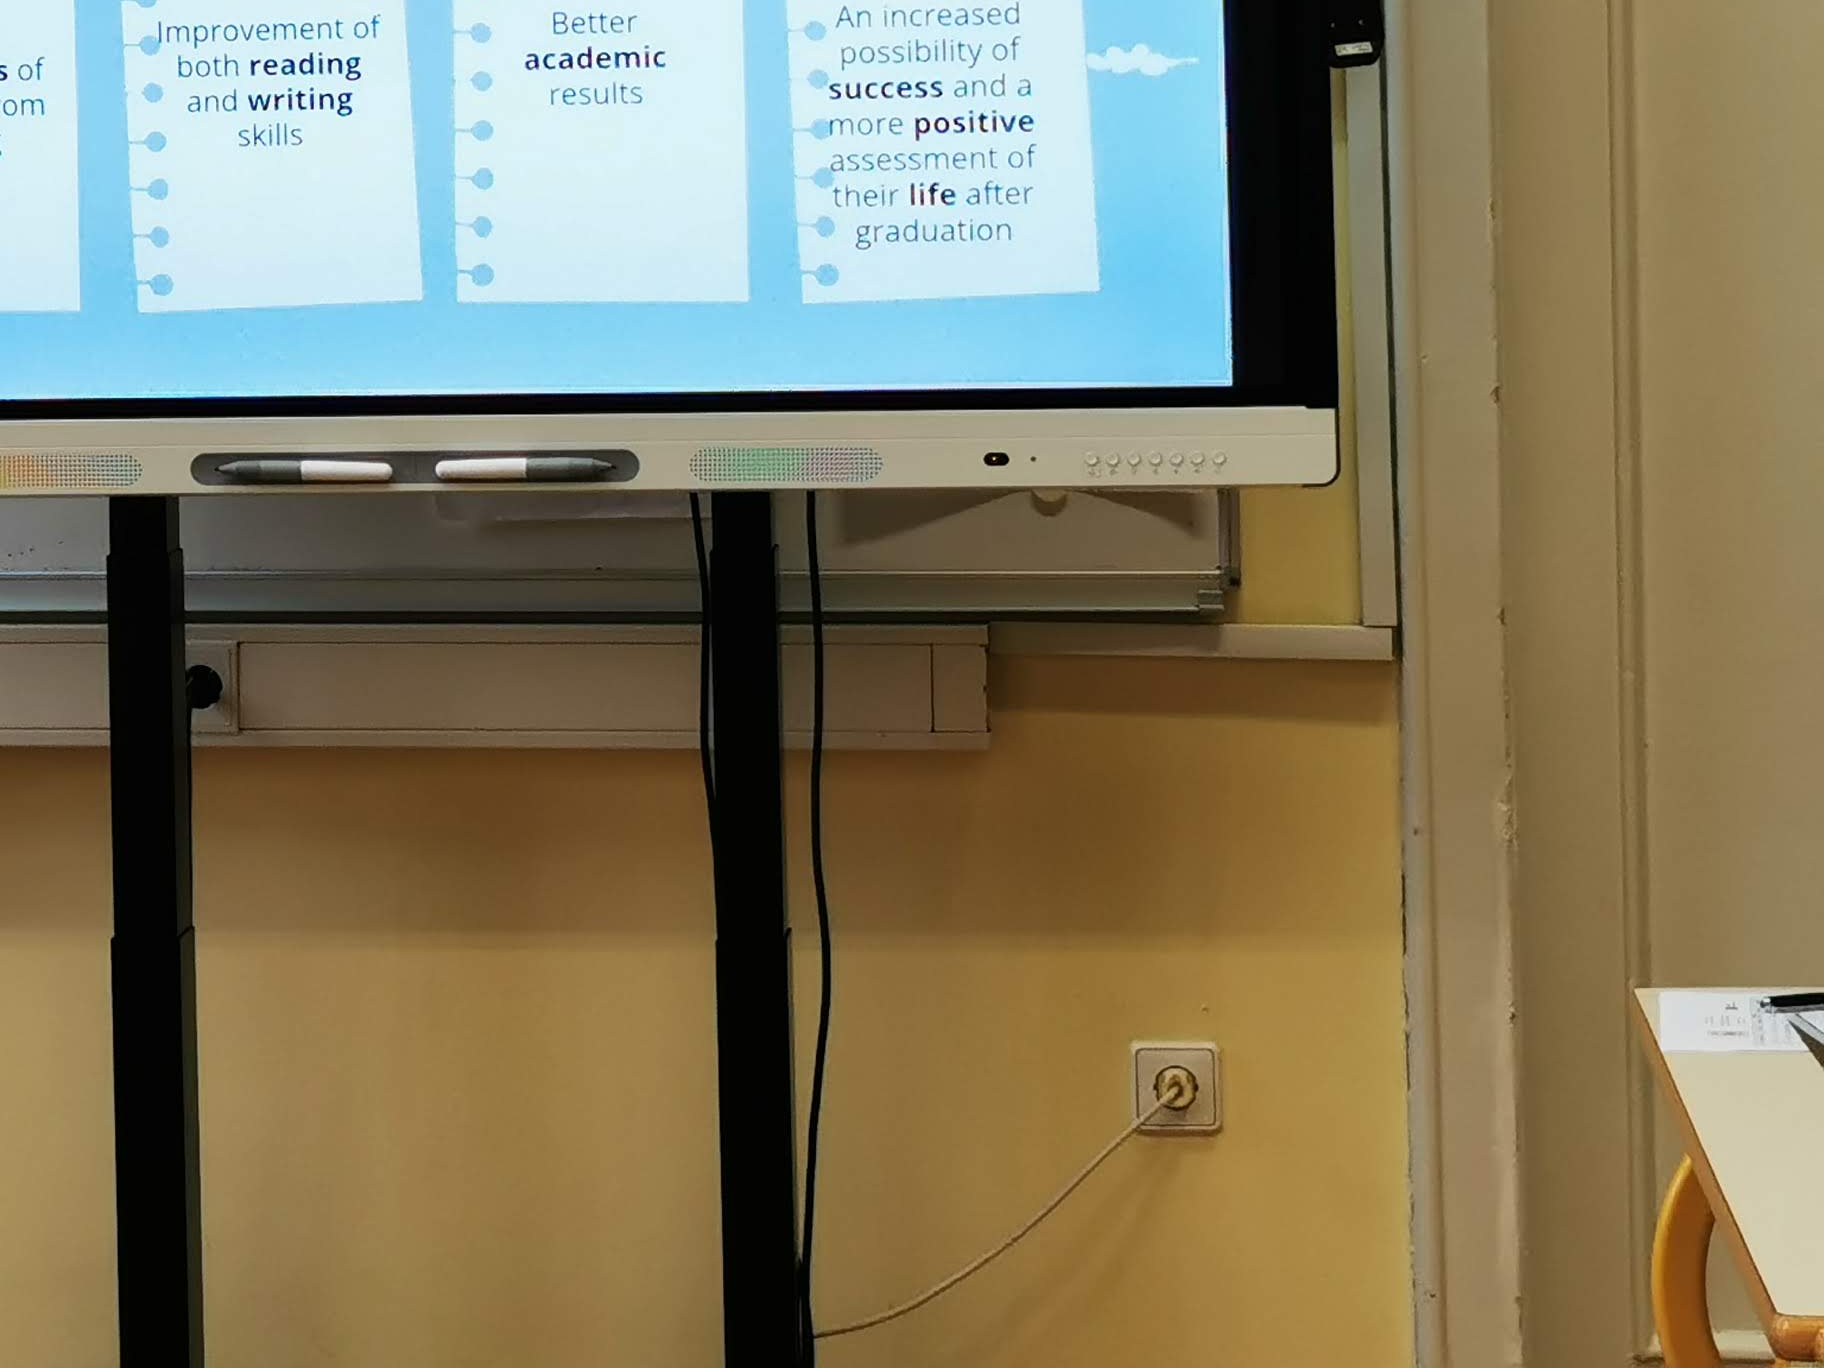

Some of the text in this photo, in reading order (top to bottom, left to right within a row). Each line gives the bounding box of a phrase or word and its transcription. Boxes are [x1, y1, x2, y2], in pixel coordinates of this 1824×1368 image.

[552, 11, 638, 36] Better
[835, 1, 1020, 29] An increased
[158, 14, 381, 49] Improvement of
[177, 51, 362, 82] both reading
[524, 45, 666, 71] academic
[840, 35, 1022, 72] possibility of
[17, 56, 46, 82] of
[550, 81, 644, 106] results
[828, 72, 1032, 100] success and a
[187, 87, 353, 117] and writing
[237, 122, 304, 148] skills
[829, 110, 1034, 141] more positive
[829, 144, 1036, 172] assessment of
[832, 179, 1034, 208] their life after
[855, 218, 1012, 251] graduation
